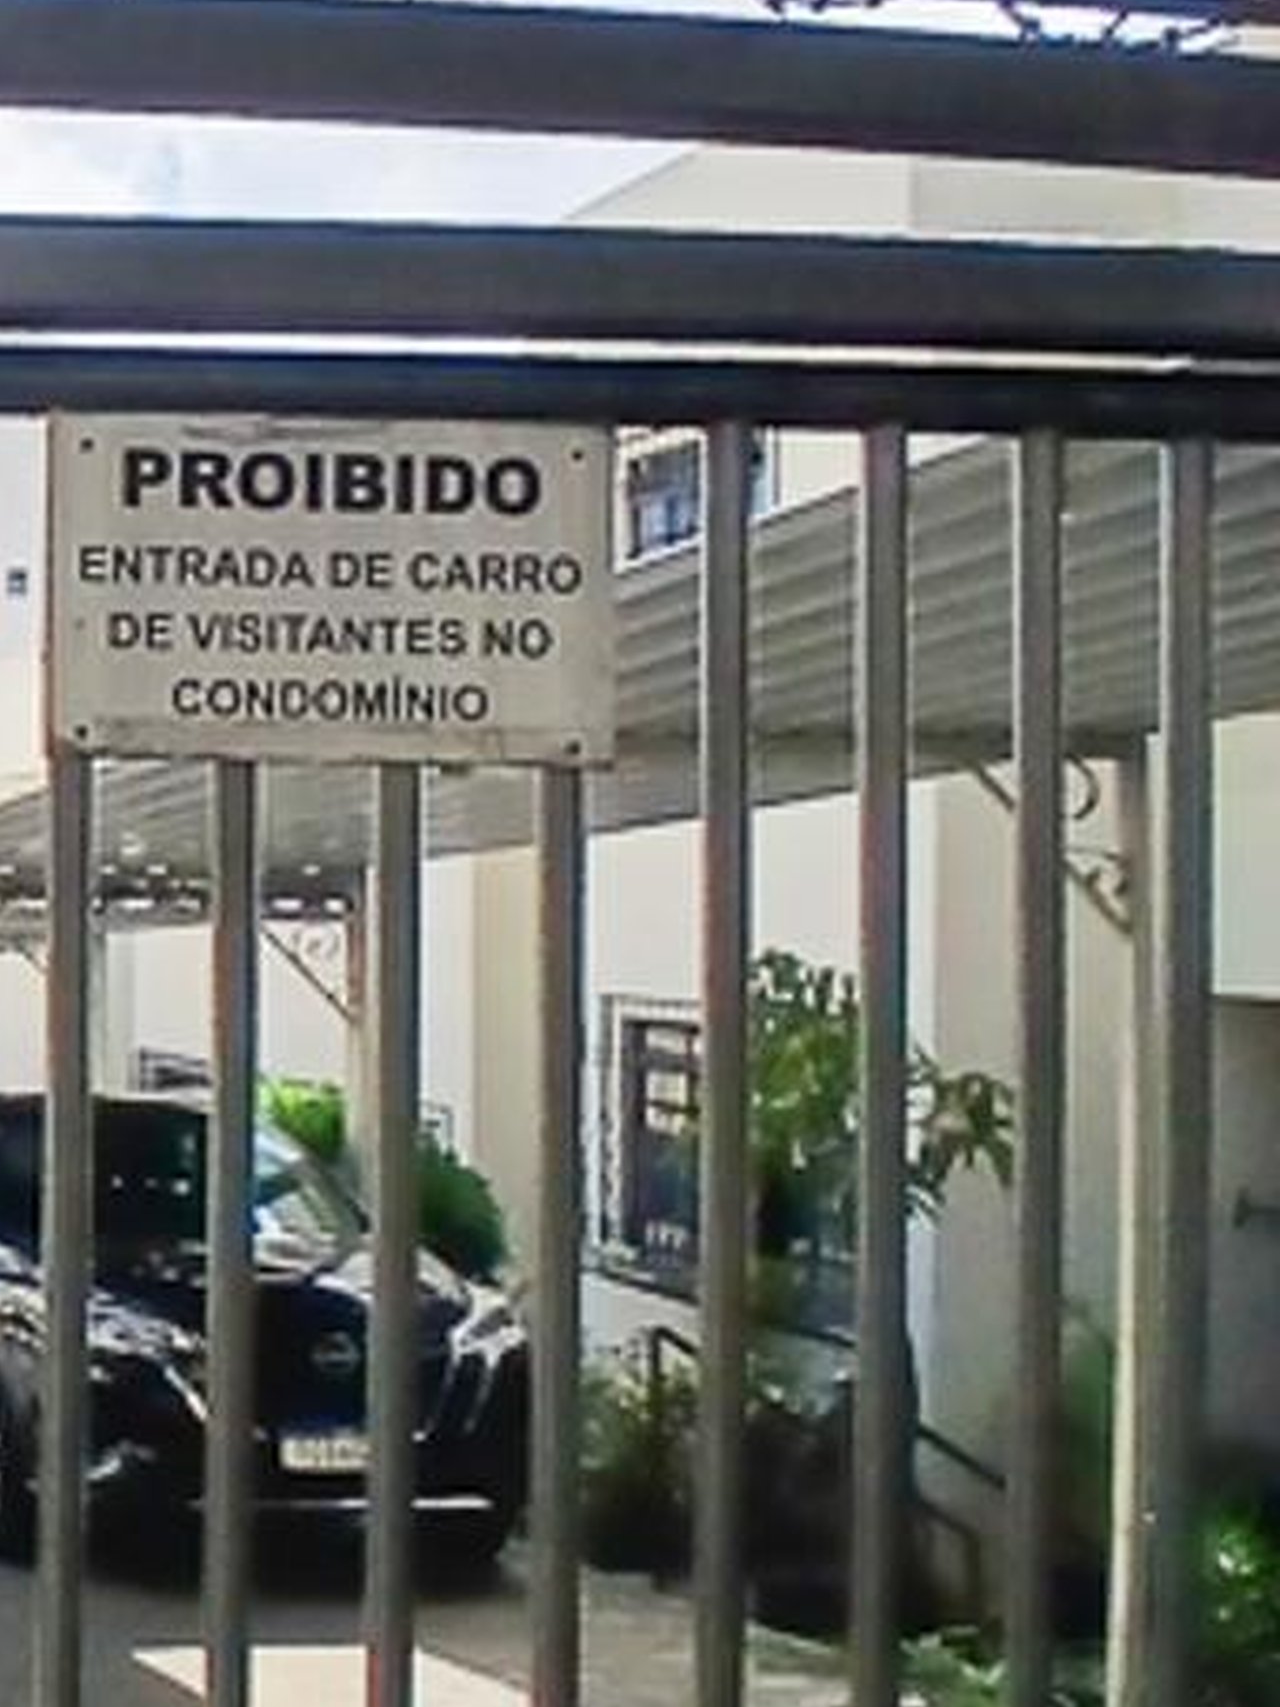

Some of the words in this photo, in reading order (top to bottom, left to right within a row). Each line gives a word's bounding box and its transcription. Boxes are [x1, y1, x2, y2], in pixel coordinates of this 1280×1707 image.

[122, 447, 542, 516] PROIBIDO
[78, 545, 315, 590] ENTRADA
[329, 551, 395, 590] DE
[407, 552, 584, 595] CARRO
[107, 612, 173, 651] DE
[186, 613, 467, 658] VISITANTES
[482, 619, 554, 660] NO
[171, 674, 490, 723] CONDOMÍNIO
